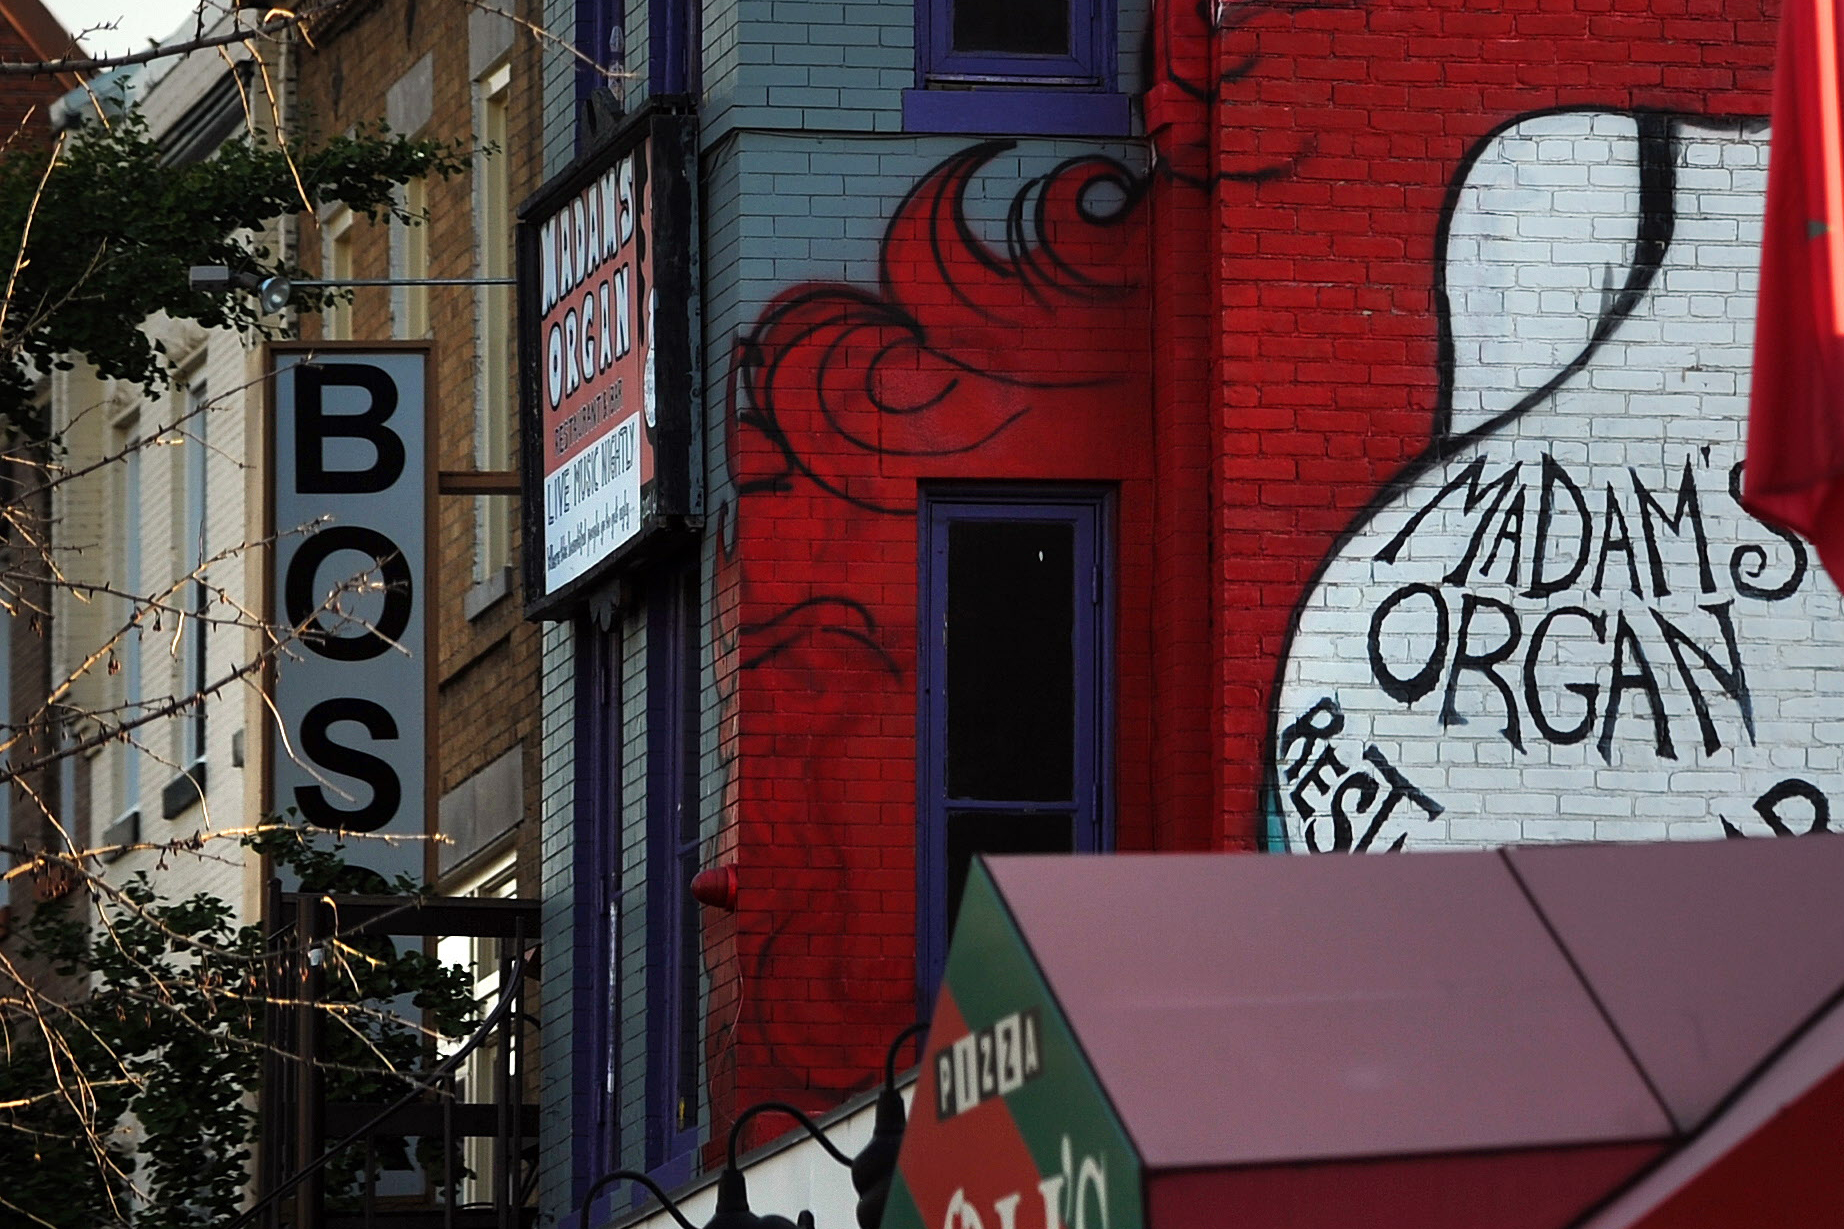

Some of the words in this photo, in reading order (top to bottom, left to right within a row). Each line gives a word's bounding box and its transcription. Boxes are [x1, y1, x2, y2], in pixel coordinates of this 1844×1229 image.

[547, 263, 631, 411] ORGAN
[547, 468, 570, 526] LIVE
[573, 446, 599, 507] MUSIC
[1373, 446, 1807, 601] MADAM'S
[1367, 582, 1756, 765] ORGAN
[936, 1010, 1041, 1120] PIZZA
